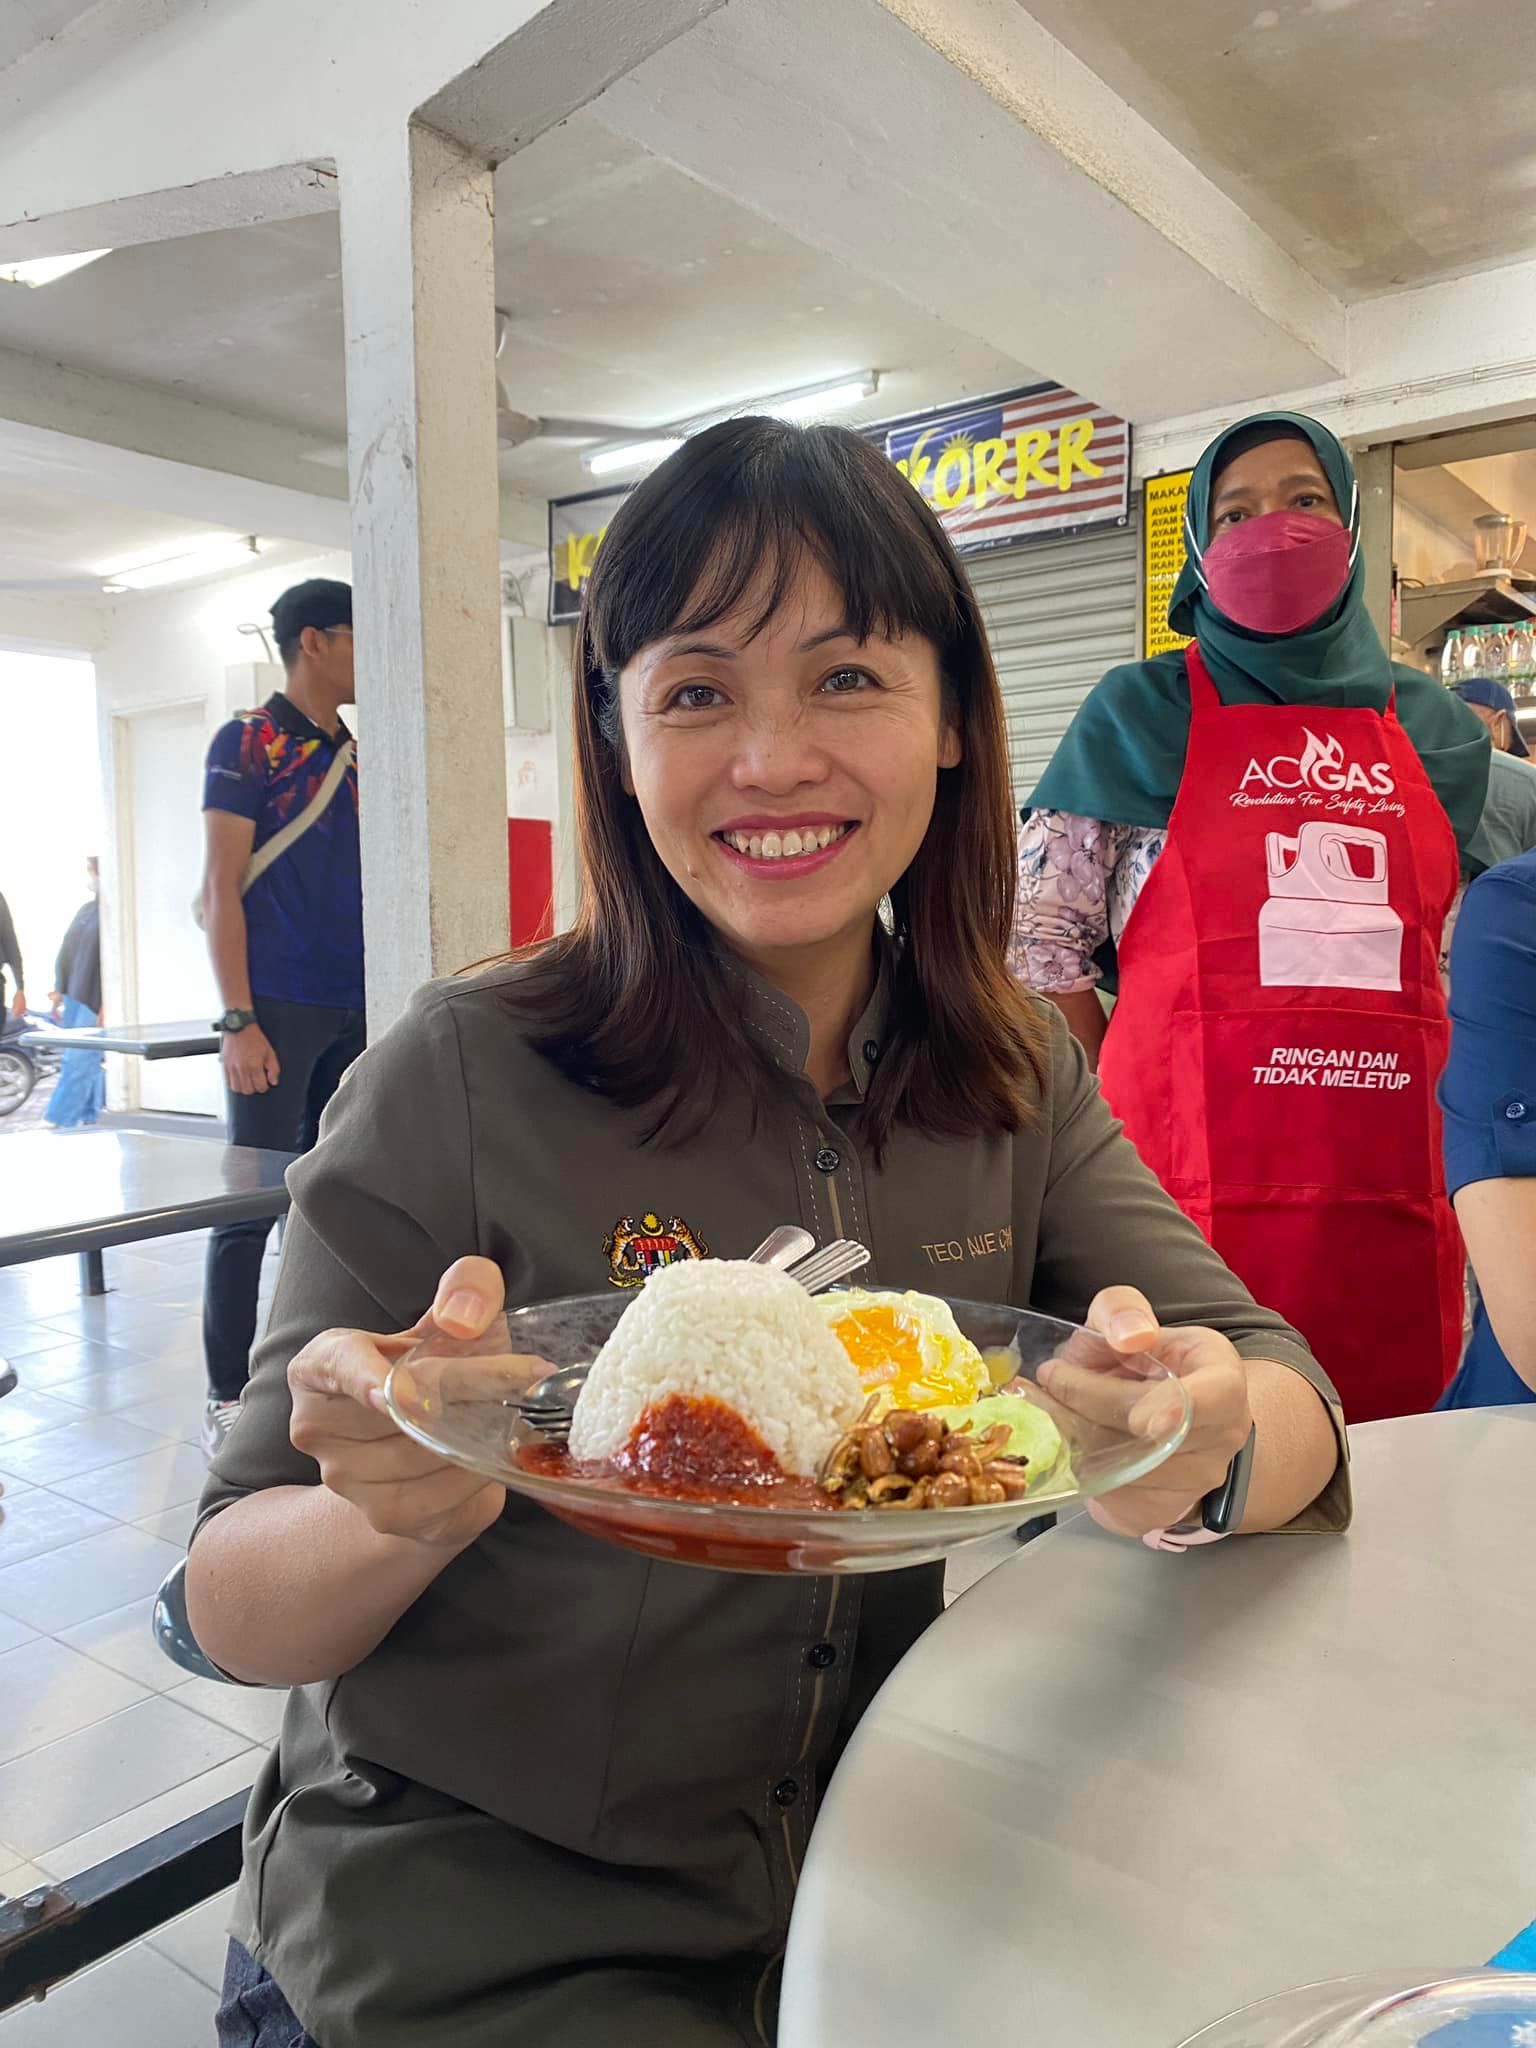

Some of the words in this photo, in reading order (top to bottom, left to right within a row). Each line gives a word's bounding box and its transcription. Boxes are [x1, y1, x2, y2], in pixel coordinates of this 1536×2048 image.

[1150, 486, 1189, 501] MAKA
[1152, 504, 1177, 517] AYAM
[1152, 516, 1177, 528] AYAM
[1152, 527, 1177, 538] AYAM
[1151, 538, 1175, 549] IKAN
[1151, 549, 1175, 560] IKAN
[1151, 560, 1175, 570] IKAN
[1229, 791, 1297, 809] Revolution
[1297, 791, 1323, 807] For
[1324, 794, 1366, 816] Safety
[1367, 798, 1406, 818] Living
[1270, 1047, 1355, 1068] RINGAN
[1357, 1051, 1399, 1070] DAN
[1252, 1066, 1319, 1086] TIDAK
[1320, 1069, 1412, 1091] MELETUP
